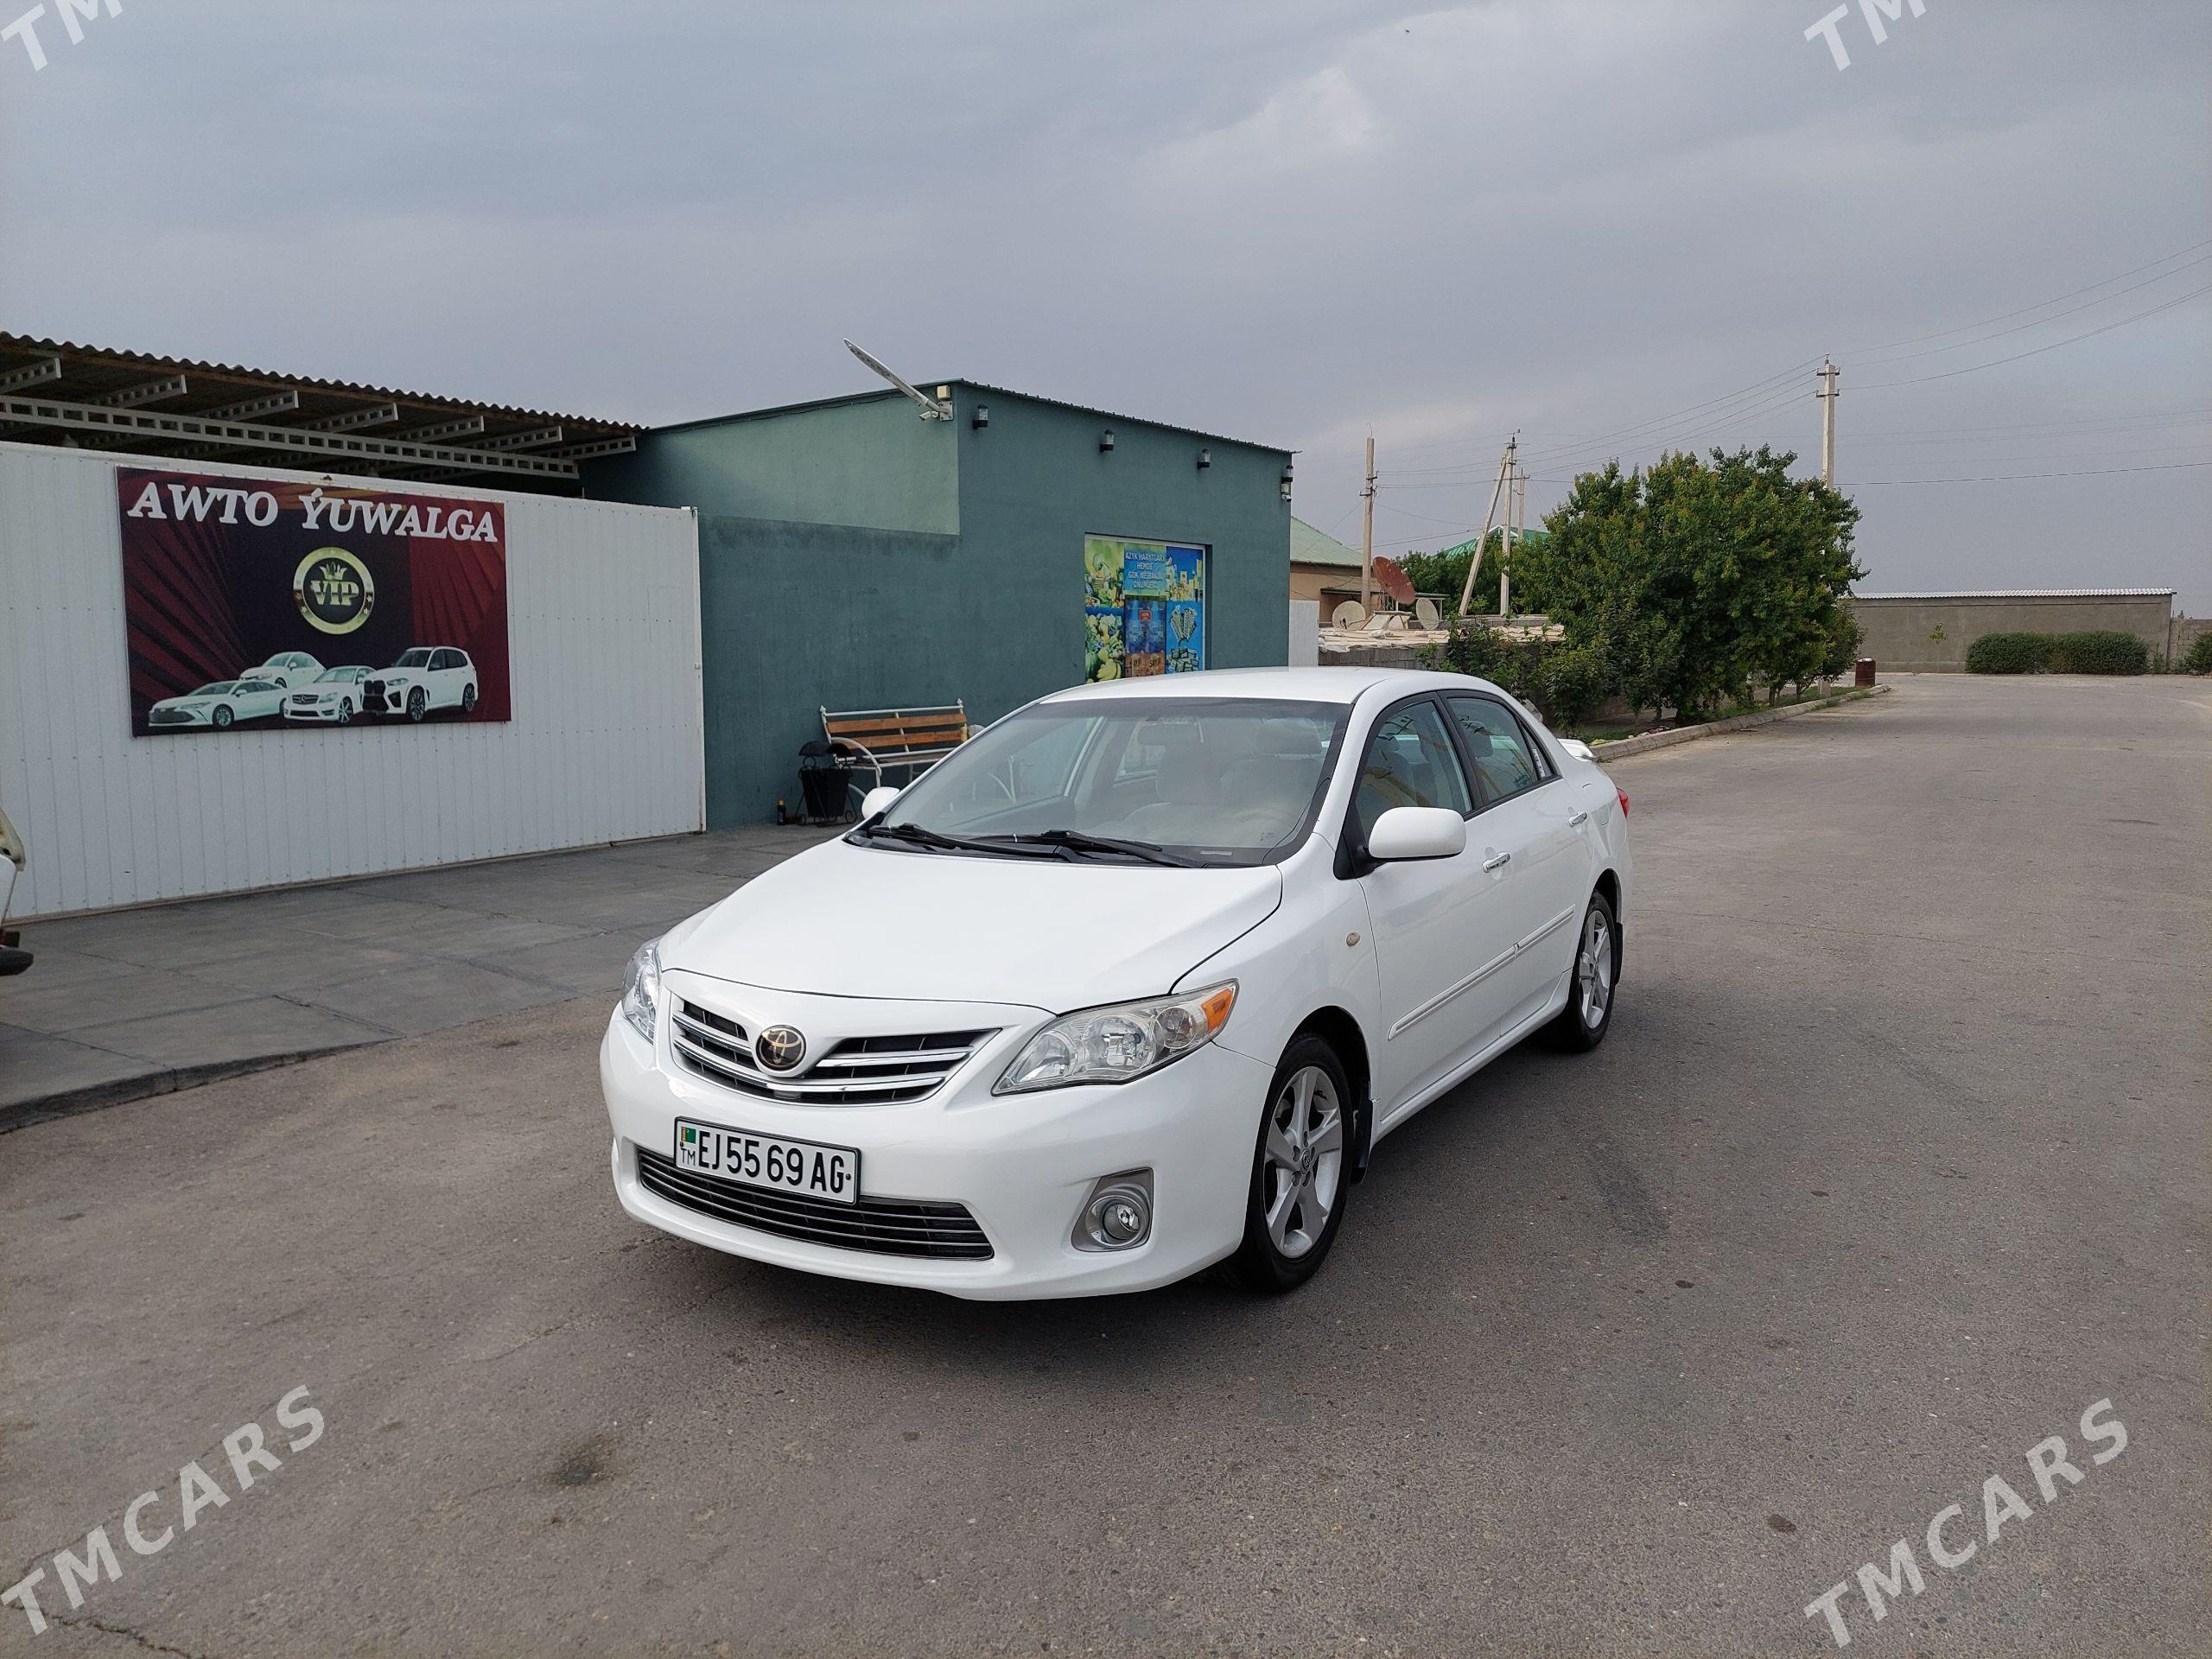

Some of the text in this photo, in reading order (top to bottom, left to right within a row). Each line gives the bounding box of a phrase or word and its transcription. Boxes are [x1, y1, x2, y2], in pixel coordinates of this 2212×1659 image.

[127, 482, 498, 542] AWTO ÝUWALGA
[310, 580, 359, 606] VIP
[680, 1147, 696, 1166] TM
